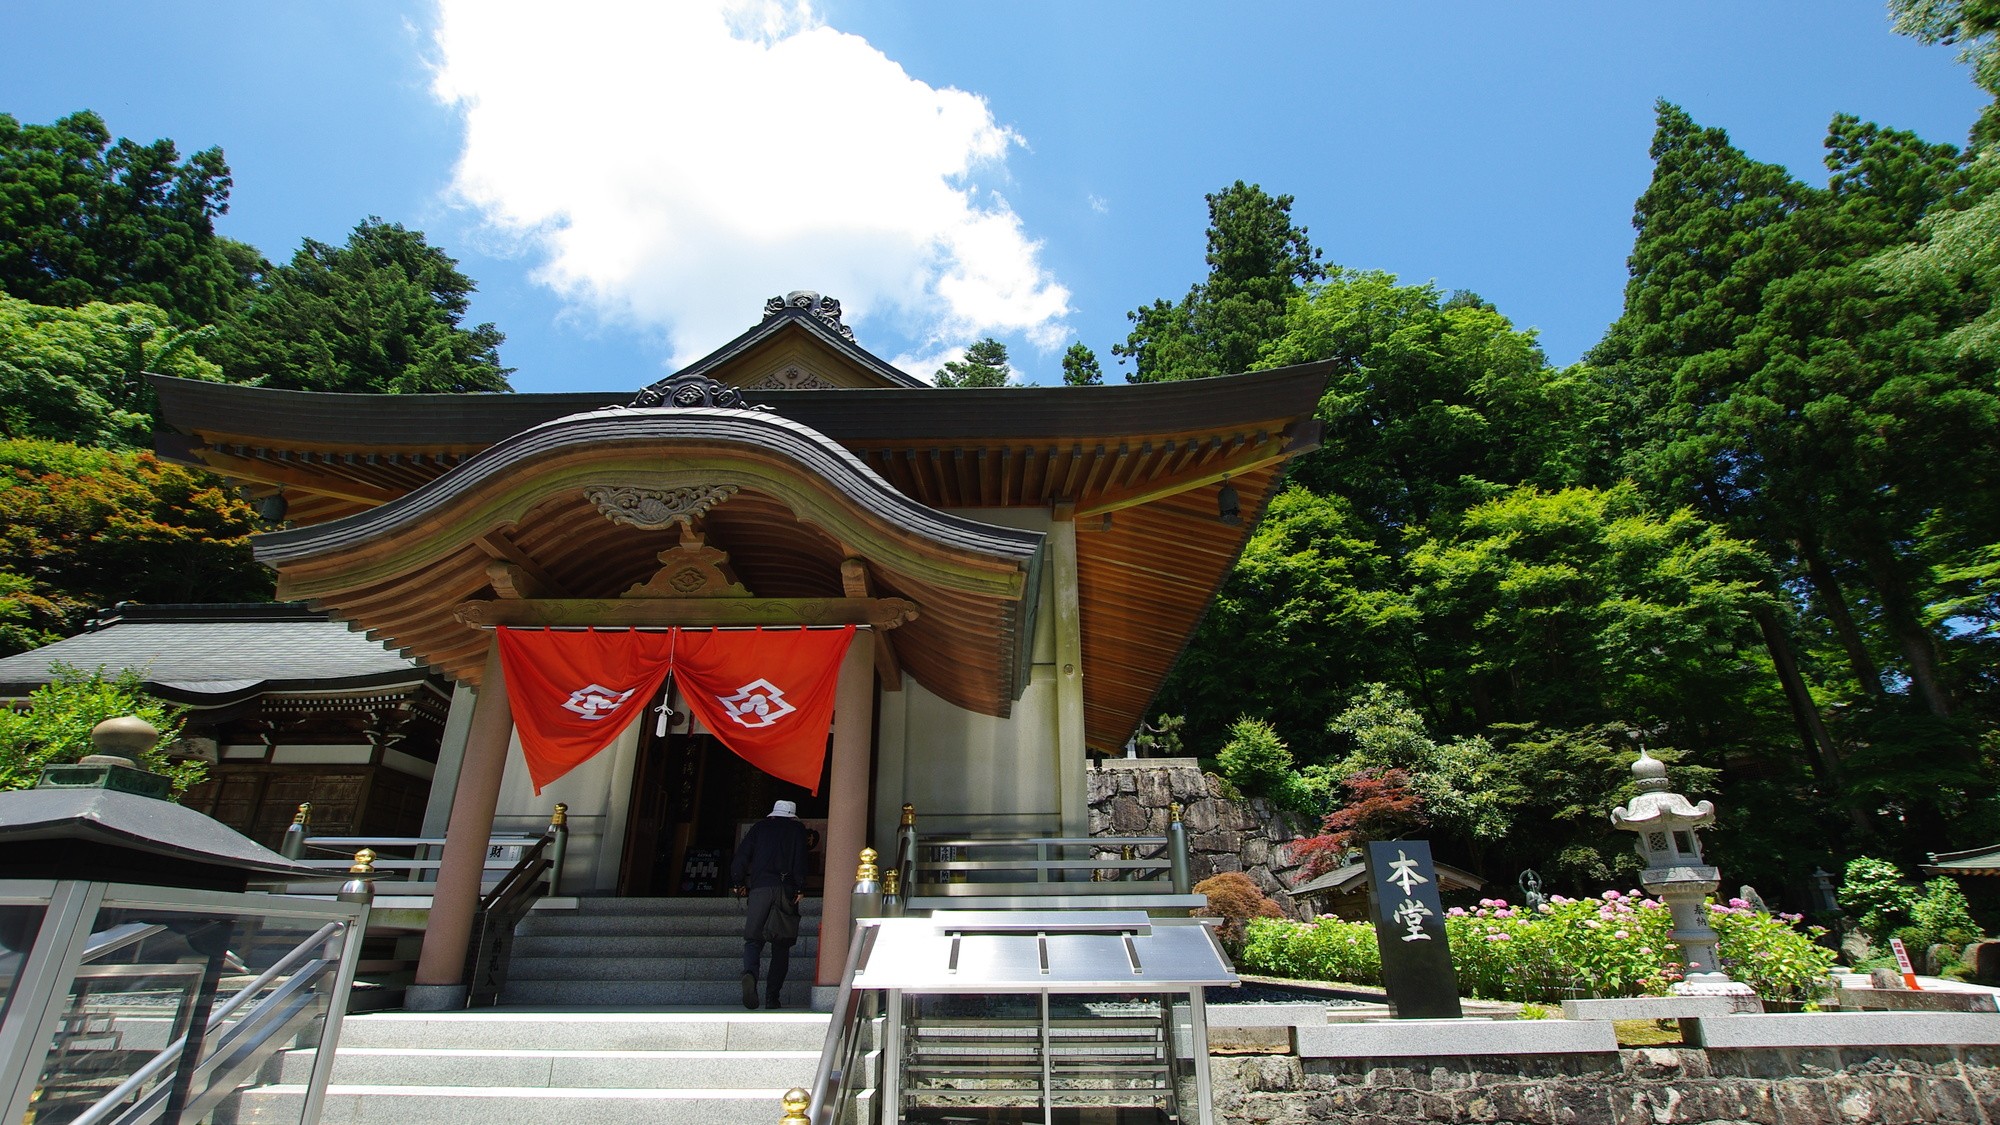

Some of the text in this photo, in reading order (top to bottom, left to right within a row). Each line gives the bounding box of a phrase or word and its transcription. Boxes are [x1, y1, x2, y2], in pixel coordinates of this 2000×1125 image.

[489, 845, 503, 858] 財
[1386, 849, 1433, 942] 本堂
[1694, 903, 1707, 927] 奉納
